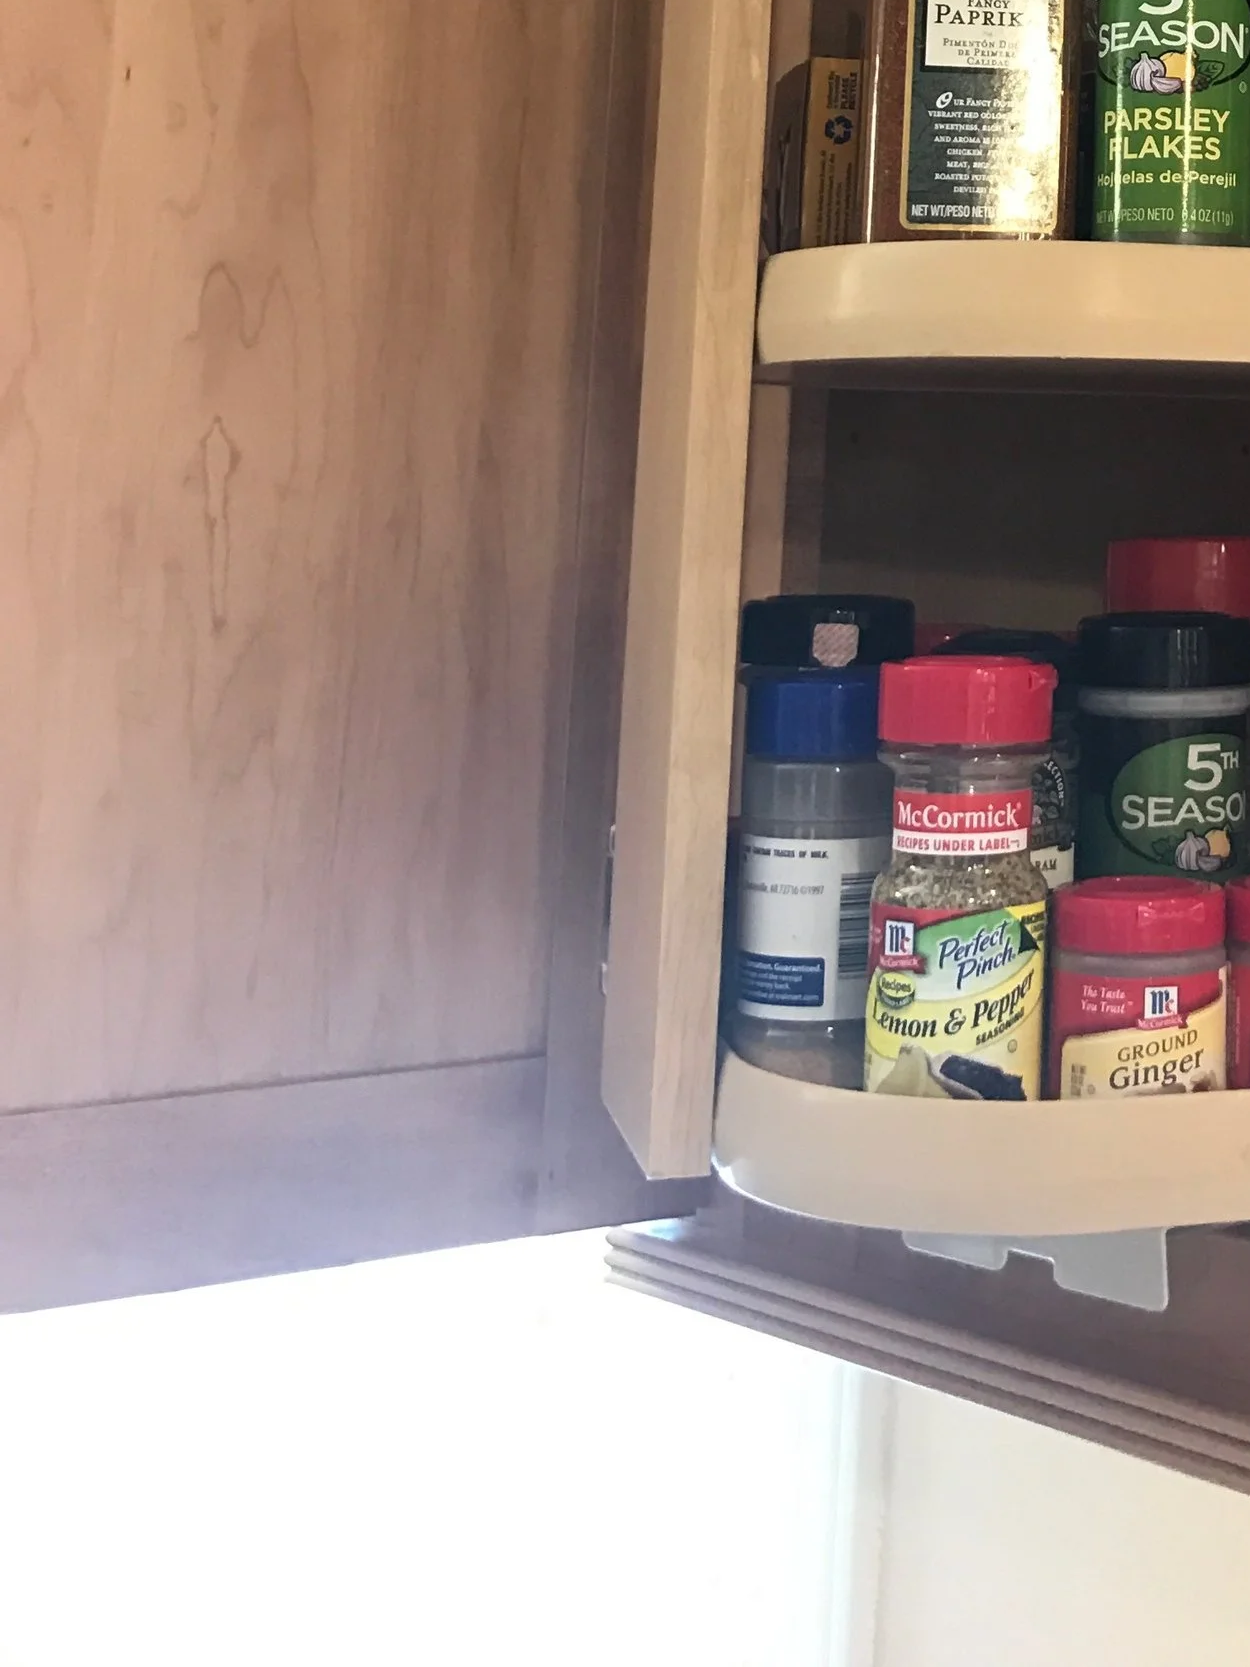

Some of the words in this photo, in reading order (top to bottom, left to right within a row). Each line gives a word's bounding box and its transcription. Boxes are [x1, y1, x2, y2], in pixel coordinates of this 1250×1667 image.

[934, 3, 1024, 27] PAPRIK
[942, 36, 996, 48] PIMENTÓN
[1098, 20, 1246, 59] SEASON
[1103, 107, 1231, 134] PARSLEY
[934, 135, 952, 143] AND
[952, 135, 981, 144] AROMA
[1108, 135, 1222, 161] FLAKES
[1159, 170, 1182, 183] de
[1188, 170, 1237, 189] Perejil
[911, 204, 929, 217] NET
[930, 204, 970, 218] WT/PESO
[1147, 207, 1175, 221] NETO
[897, 800, 1019, 829] McCormick
[1121, 789, 1246, 831] SEASO
[896, 835, 930, 851] RECIPES
[933, 837, 976, 852] UNDER
[979, 837, 1011, 850] LABEL
[939, 919, 1011, 970] Perfect
[880, 976, 913, 994] Recipes
[1082, 984, 1098, 998] The
[1100, 986, 1126, 999] Taste
[872, 997, 938, 1038] Lemon
[943, 1007, 966, 1036] &
[970, 968, 1035, 1029] Pepper
[1081, 999, 1098, 1011] You
[975, 1006, 1026, 1046] SEASONING
[1117, 1029, 1198, 1063] GROUND
[1109, 1047, 1204, 1090] Ginger
